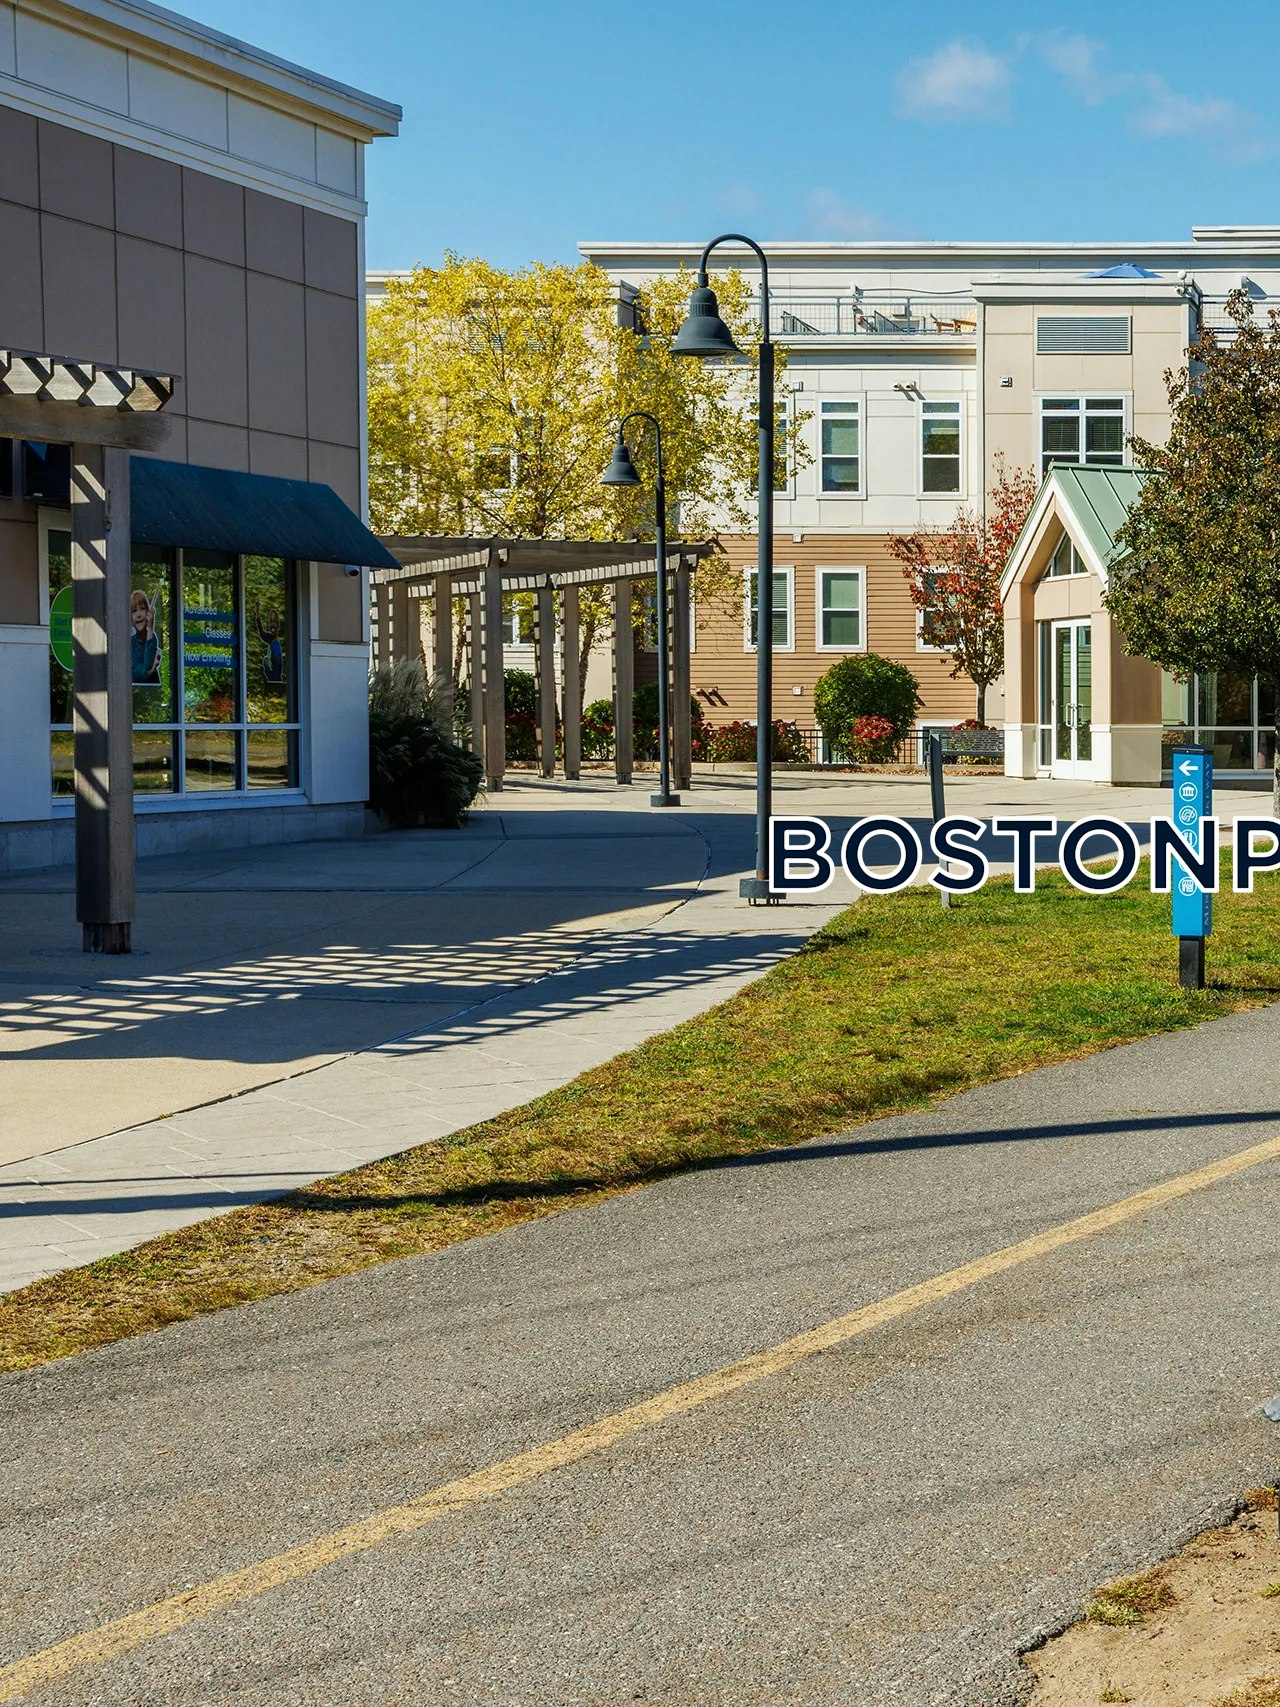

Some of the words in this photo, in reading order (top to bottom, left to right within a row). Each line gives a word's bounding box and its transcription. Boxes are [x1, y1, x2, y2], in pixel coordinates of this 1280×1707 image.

[205, 627, 232, 639] Classes
[185, 652, 200, 662] Now
[202, 652, 231, 666] Enrolling
